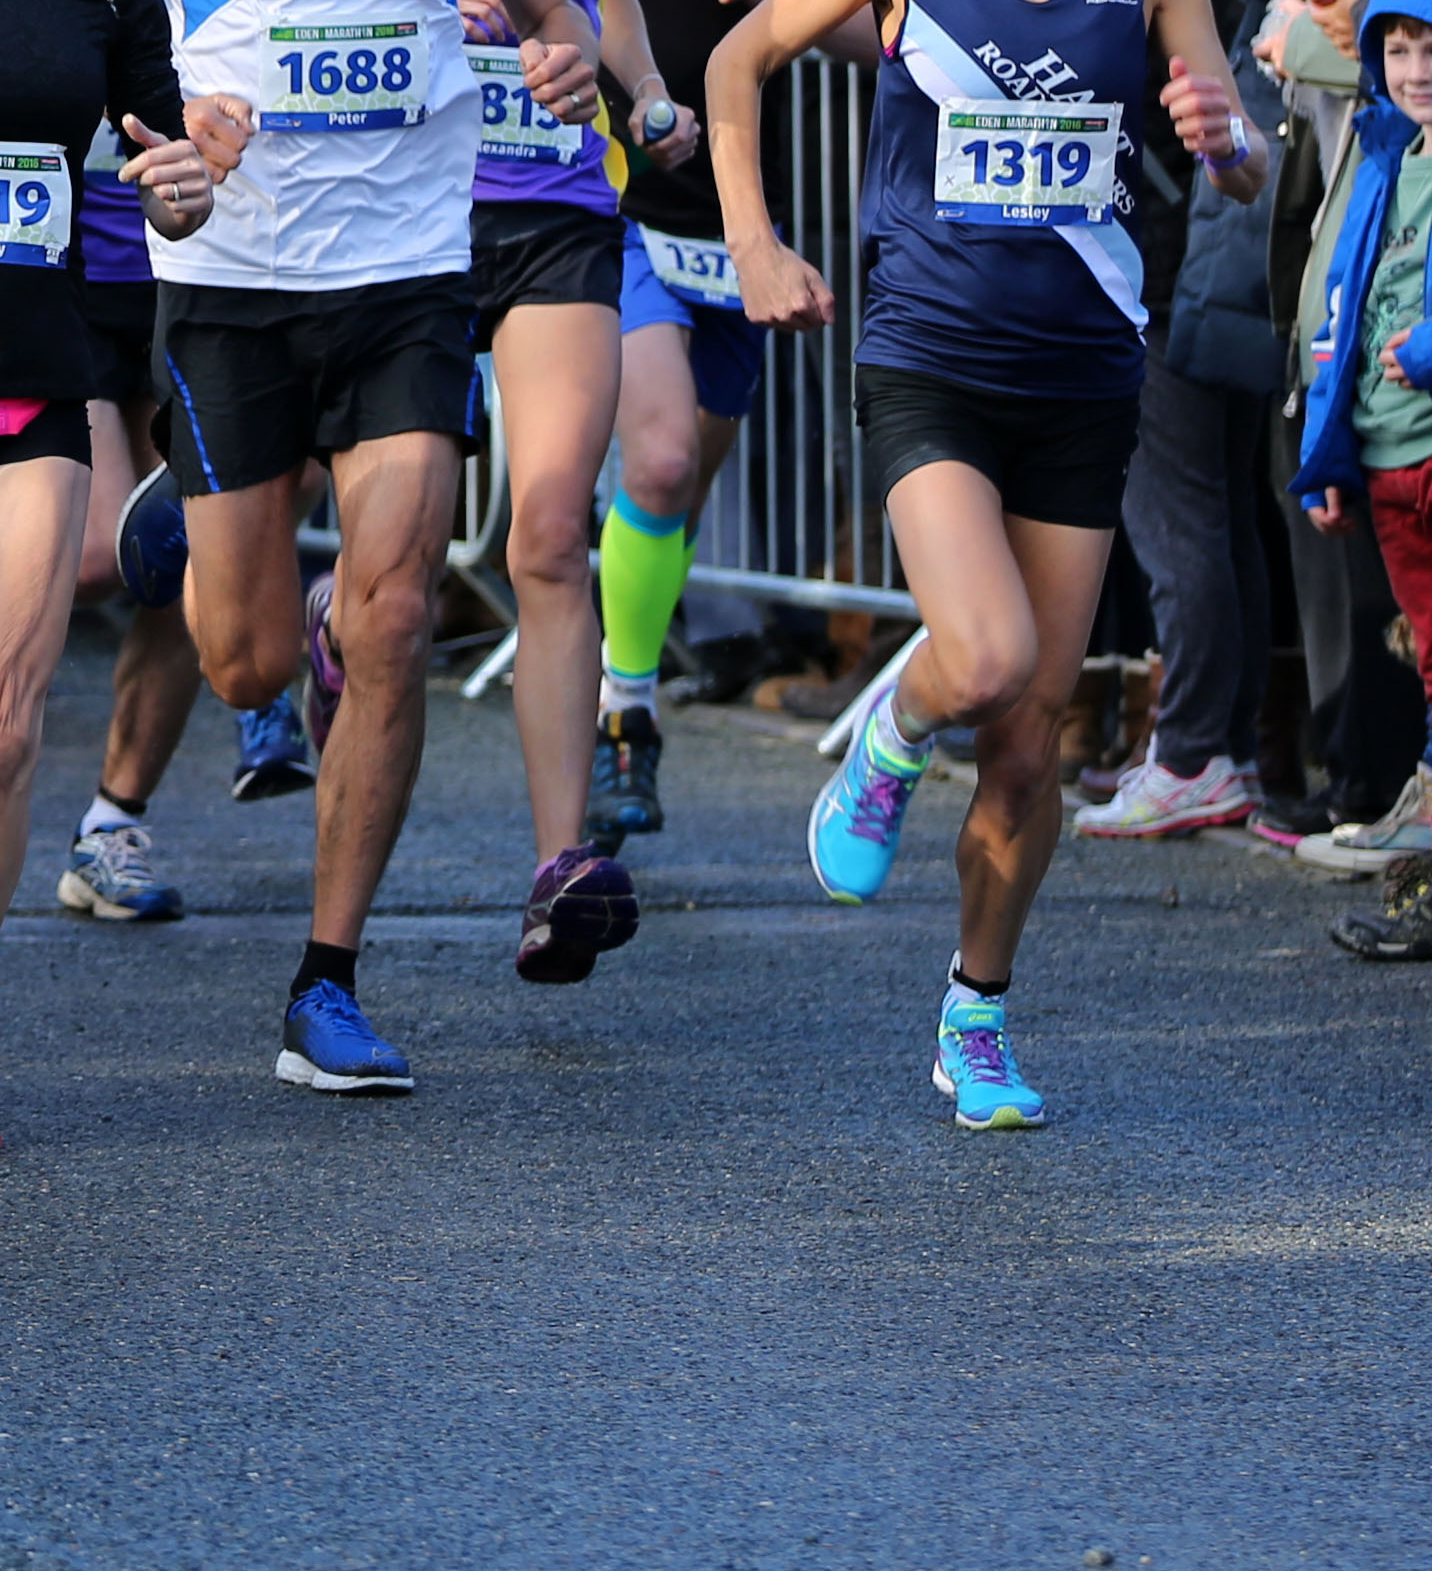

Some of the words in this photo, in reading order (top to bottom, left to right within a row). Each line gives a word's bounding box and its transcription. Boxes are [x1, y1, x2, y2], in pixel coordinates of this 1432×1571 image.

[294, 28, 320, 40] EDEN
[277, 47, 412, 96] 1688
[329, 112, 367, 126] Peter
[976, 117, 1001, 128] EDEN
[961, 140, 1091, 188] 1319
[1003, 205, 1050, 221] Lesley
